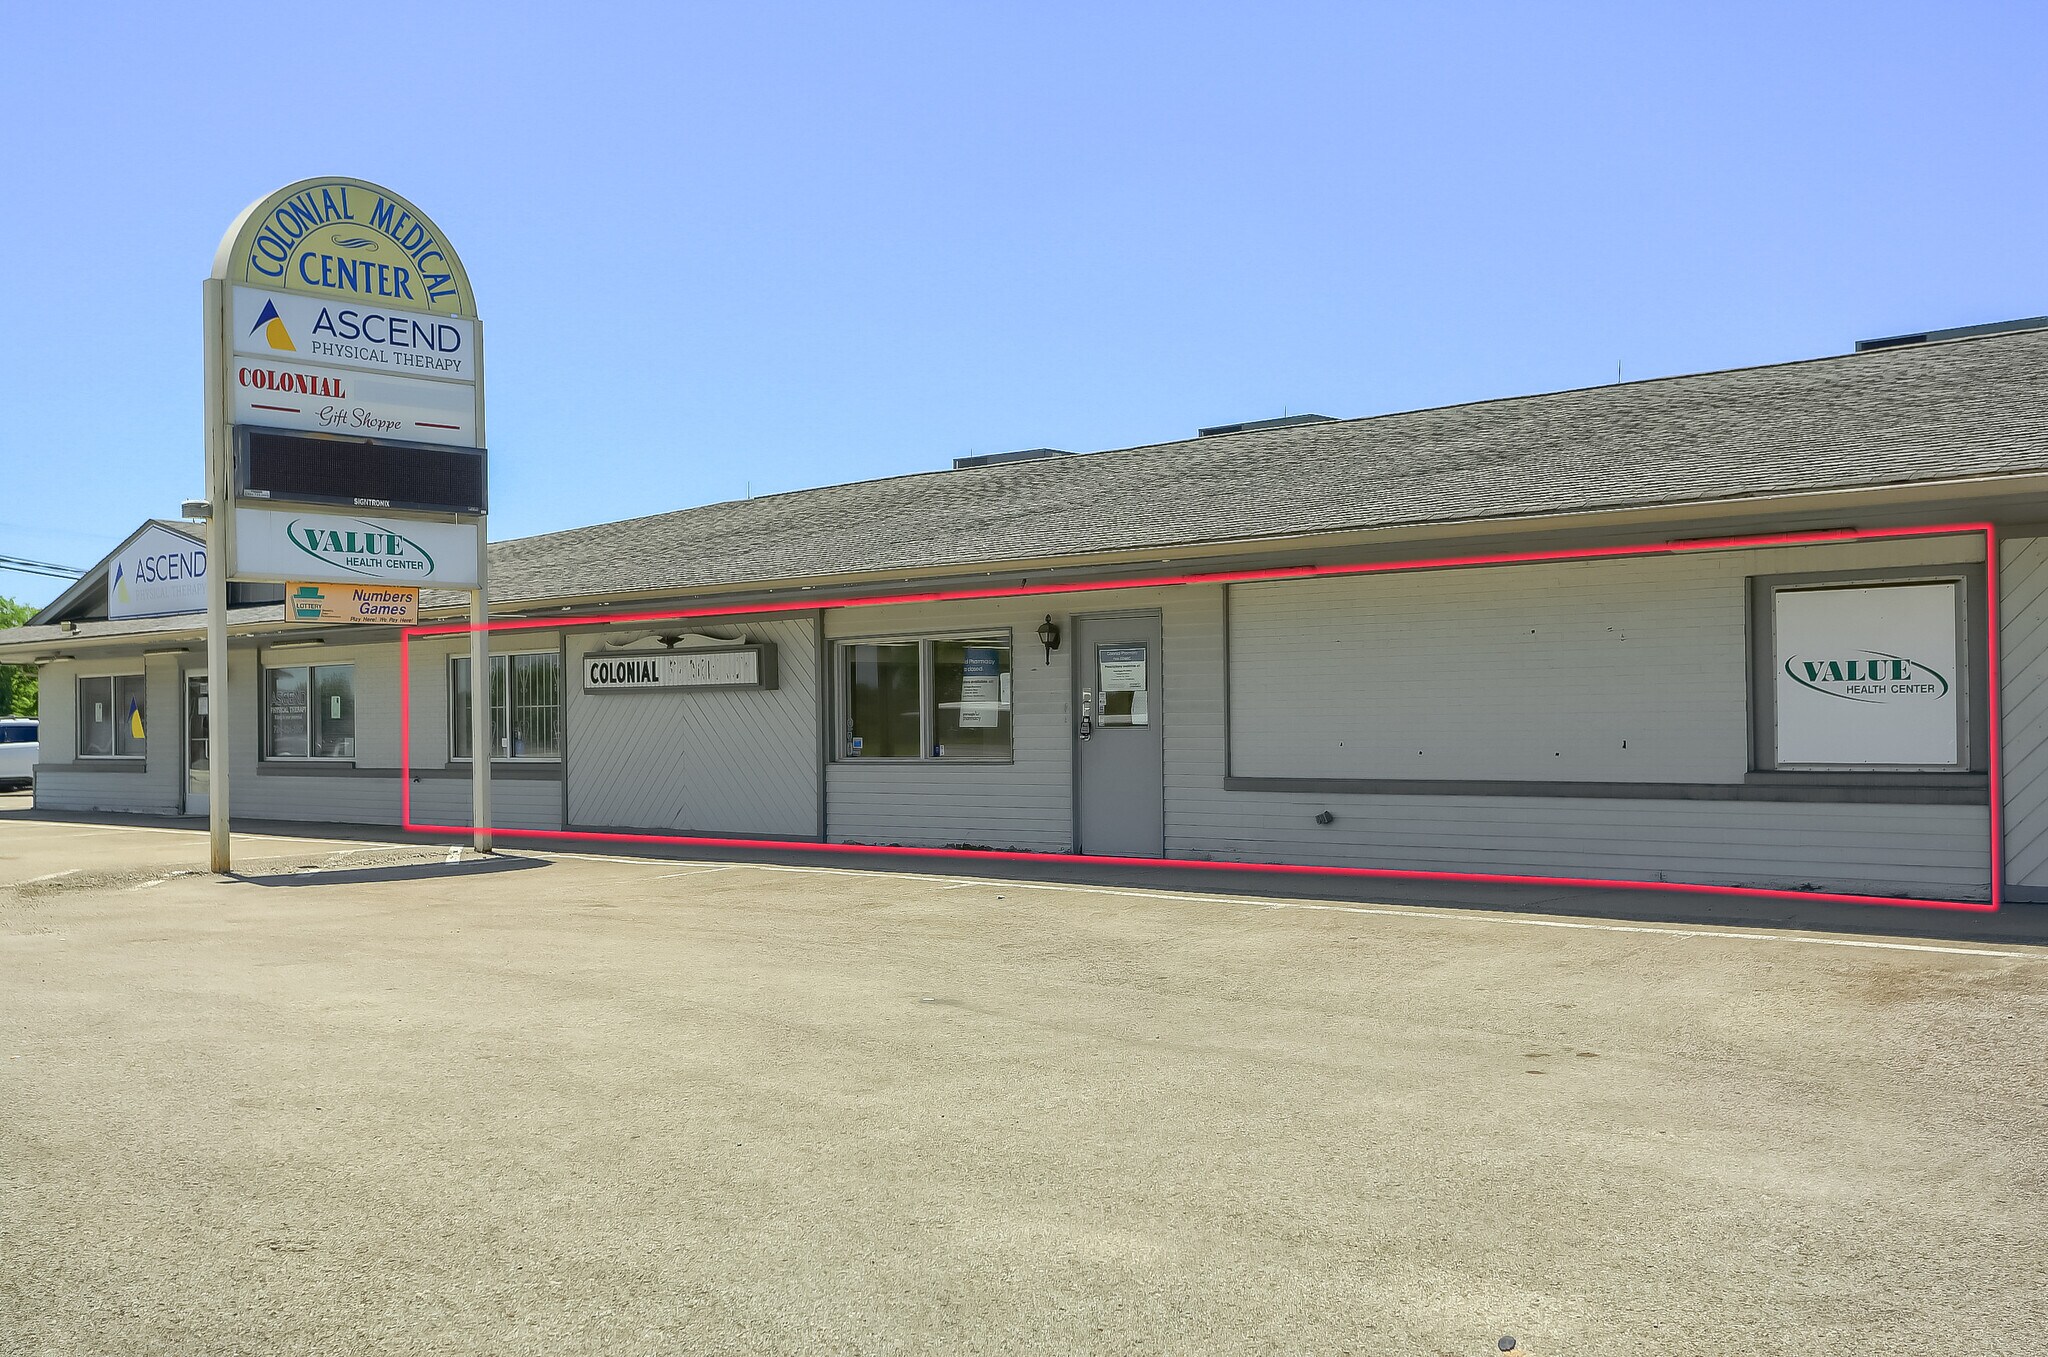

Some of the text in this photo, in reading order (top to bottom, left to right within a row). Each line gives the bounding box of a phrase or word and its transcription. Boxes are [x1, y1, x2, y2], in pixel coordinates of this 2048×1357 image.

[252, 187, 457, 304] COLONIAL MEDICAL
[299, 252, 414, 300] CENTER
[312, 307, 461, 353] ASCEND
[312, 340, 462, 373] PHYSICAL THERAPY
[239, 367, 346, 399] COLONIAL
[315, 405, 402, 432] Gift Shoppe
[353, 497, 391, 508] SIGNTRONIX
[303, 528, 404, 556] VALUE
[135, 551, 207, 584] ASCEND
[346, 556, 424, 570] HEALTH CENTER
[136, 584, 206, 600] PHYSICAL THERAPY
[353, 589, 413, 603] Numbers
[359, 602, 407, 615] Games
[590, 660, 659, 684] COLONIAL
[1802, 659, 1912, 682] VALUE
[1846, 684, 1935, 694] HEALTH CENTER
